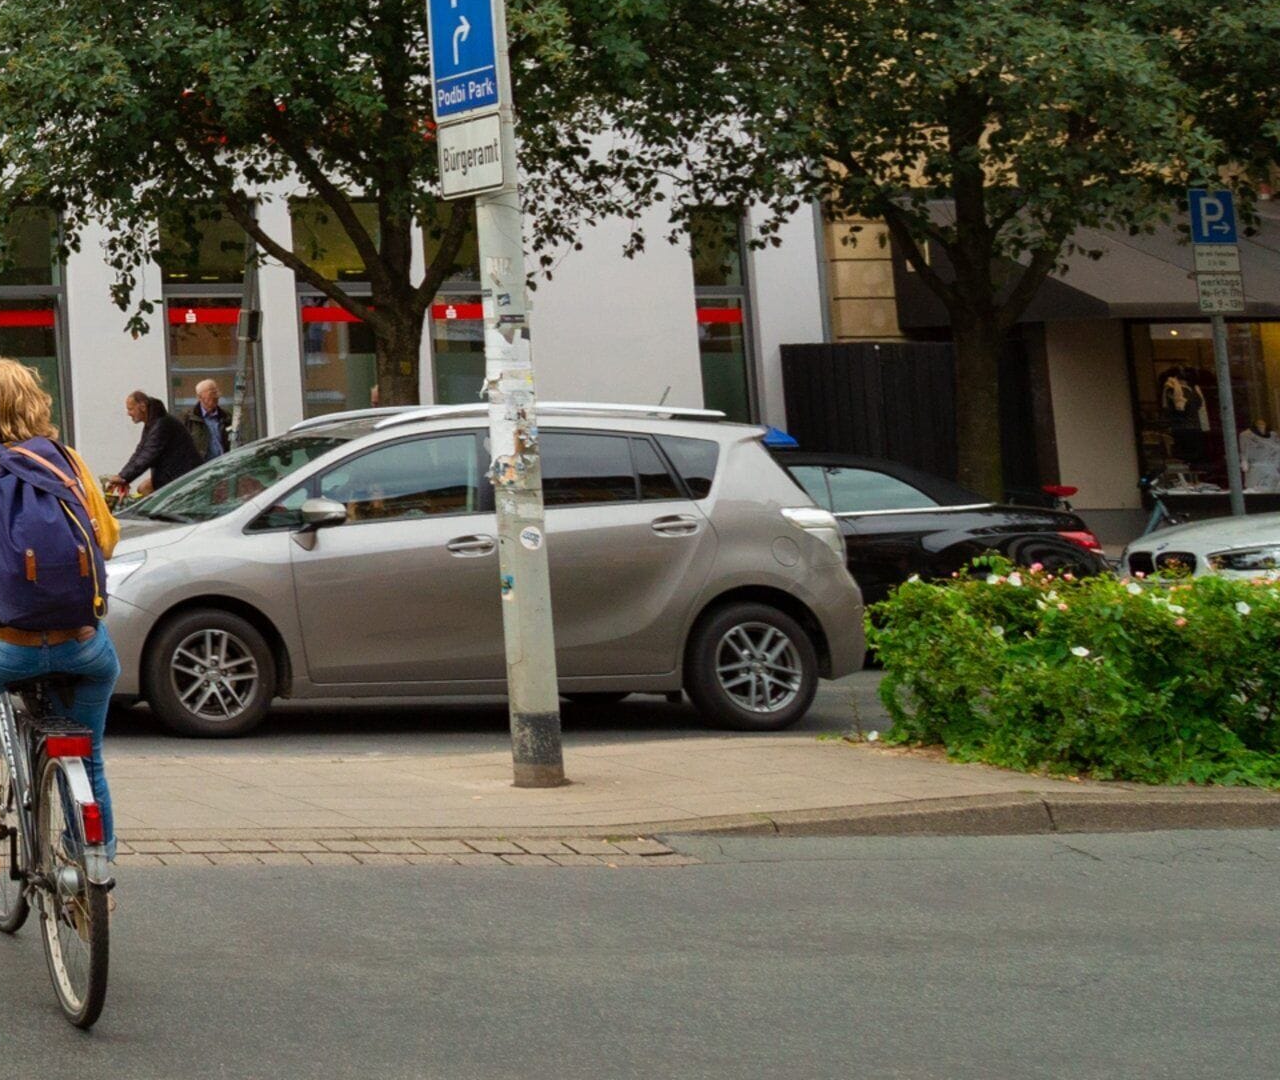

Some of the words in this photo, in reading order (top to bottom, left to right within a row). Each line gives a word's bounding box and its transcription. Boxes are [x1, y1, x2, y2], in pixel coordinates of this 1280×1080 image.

[437, 84, 465, 107] Podbi
[468, 77, 494, 100] Park
[442, 138, 499, 176] Bürgeramt
[1199, 197, 1225, 237] P
